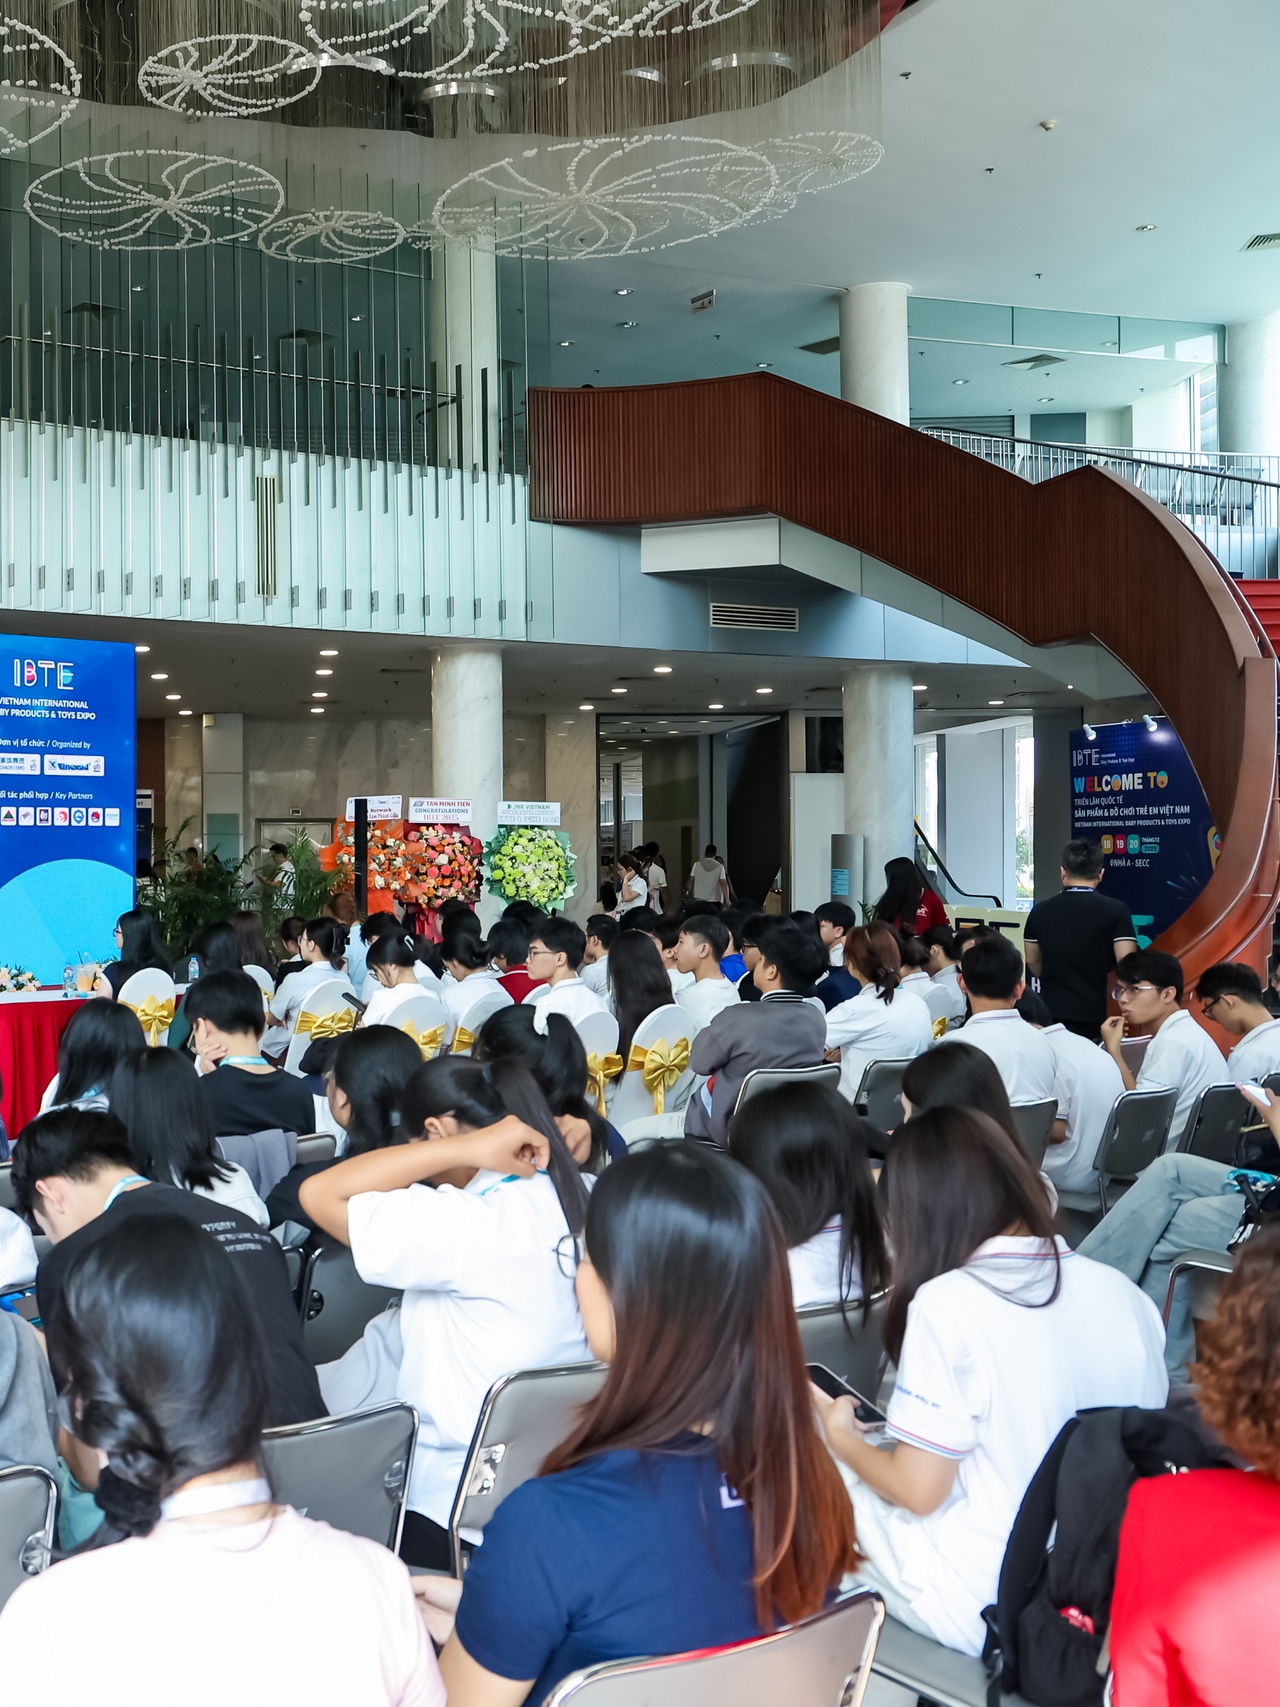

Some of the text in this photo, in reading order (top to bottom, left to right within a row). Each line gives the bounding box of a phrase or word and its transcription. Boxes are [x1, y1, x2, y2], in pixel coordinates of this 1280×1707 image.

[13, 658, 75, 691] IBTE
[32, 698, 89, 708] INTERNATIONAL
[10, 708, 50, 718] PRODUCTS
[50, 710, 57, 719] &
[57, 710, 76, 720] TOYS
[76, 711, 96, 721] EXPO
[1073, 770, 1169, 794] WELCOME TO
[1103, 839, 1139, 849] 18 19 20
